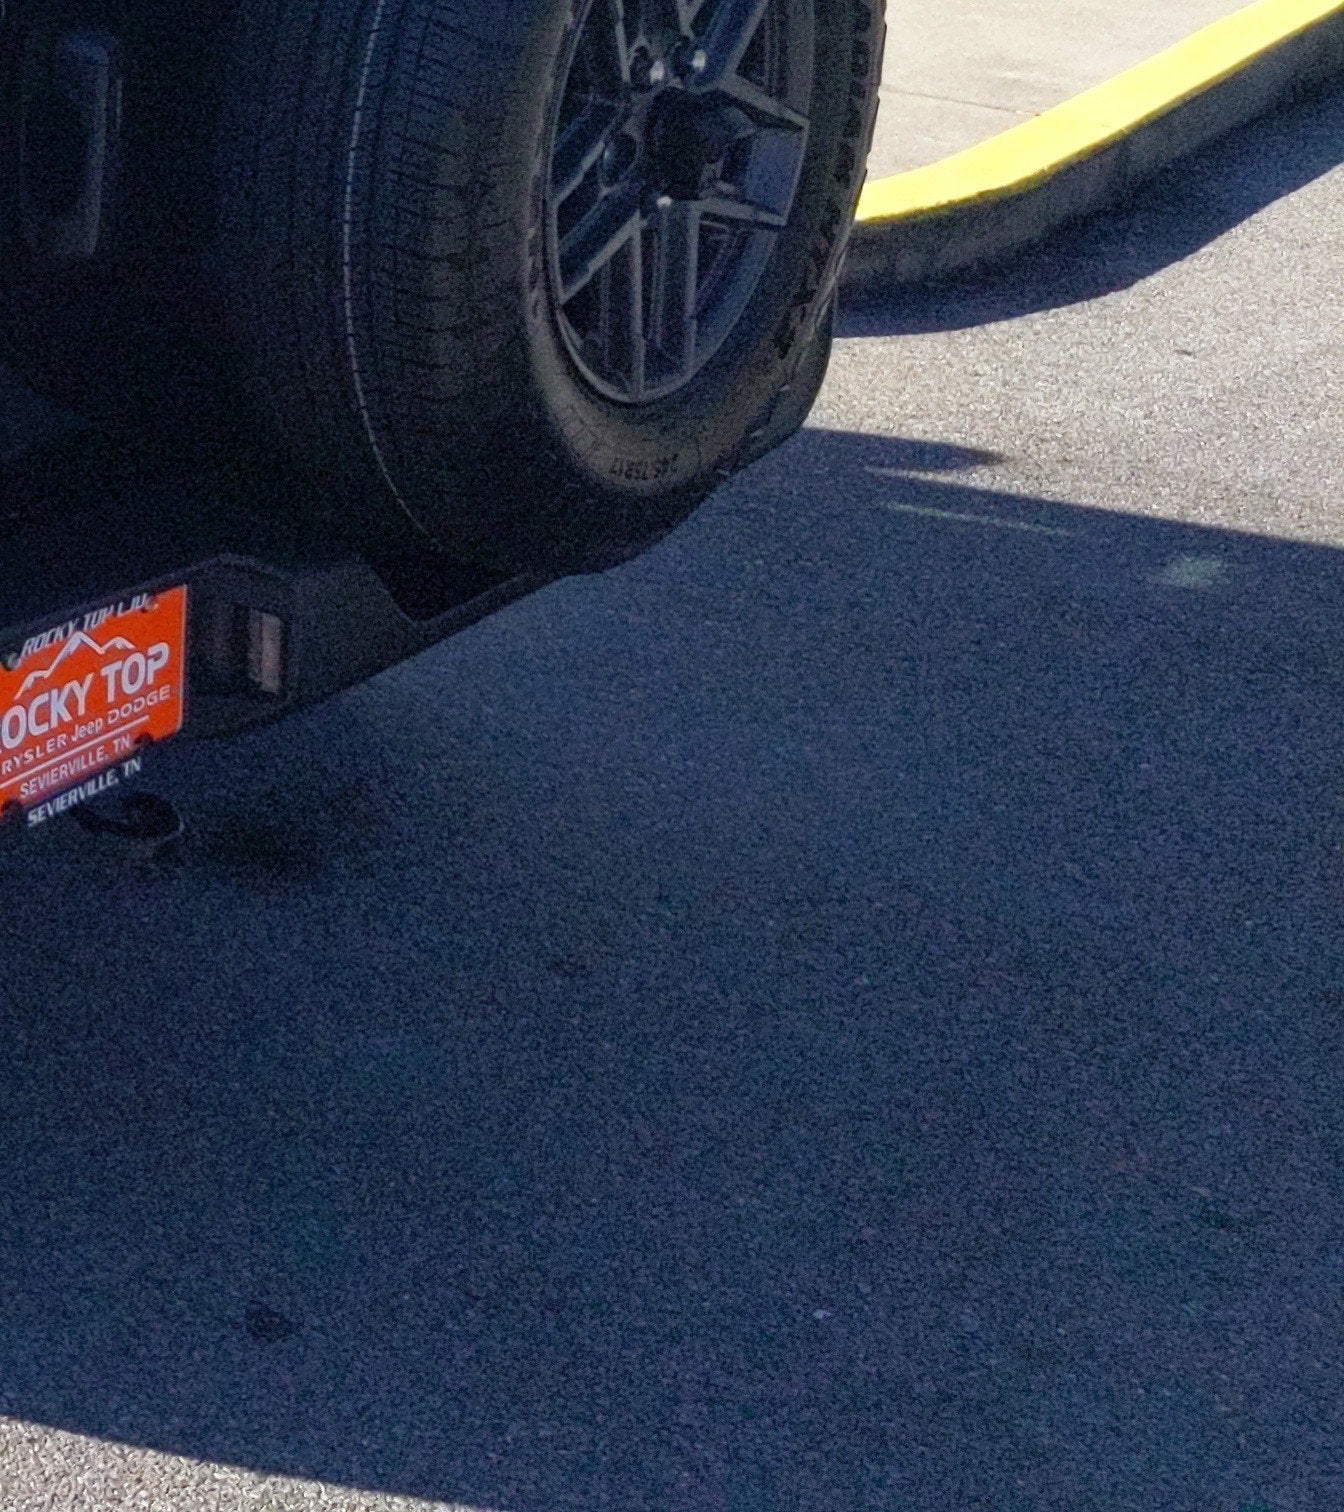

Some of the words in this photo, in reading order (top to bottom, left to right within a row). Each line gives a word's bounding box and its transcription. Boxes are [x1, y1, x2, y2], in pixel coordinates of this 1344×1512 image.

[100, 642, 170, 704] TOP
[71, 716, 104, 742] Jeep
[107, 684, 171, 725] DODGE
[19, 745, 110, 799] SEVIERVILLE,
[113, 734, 132, 755] TN
[27, 772, 120, 828] SEVIERVILLE,
[123, 756, 143, 778] TN
